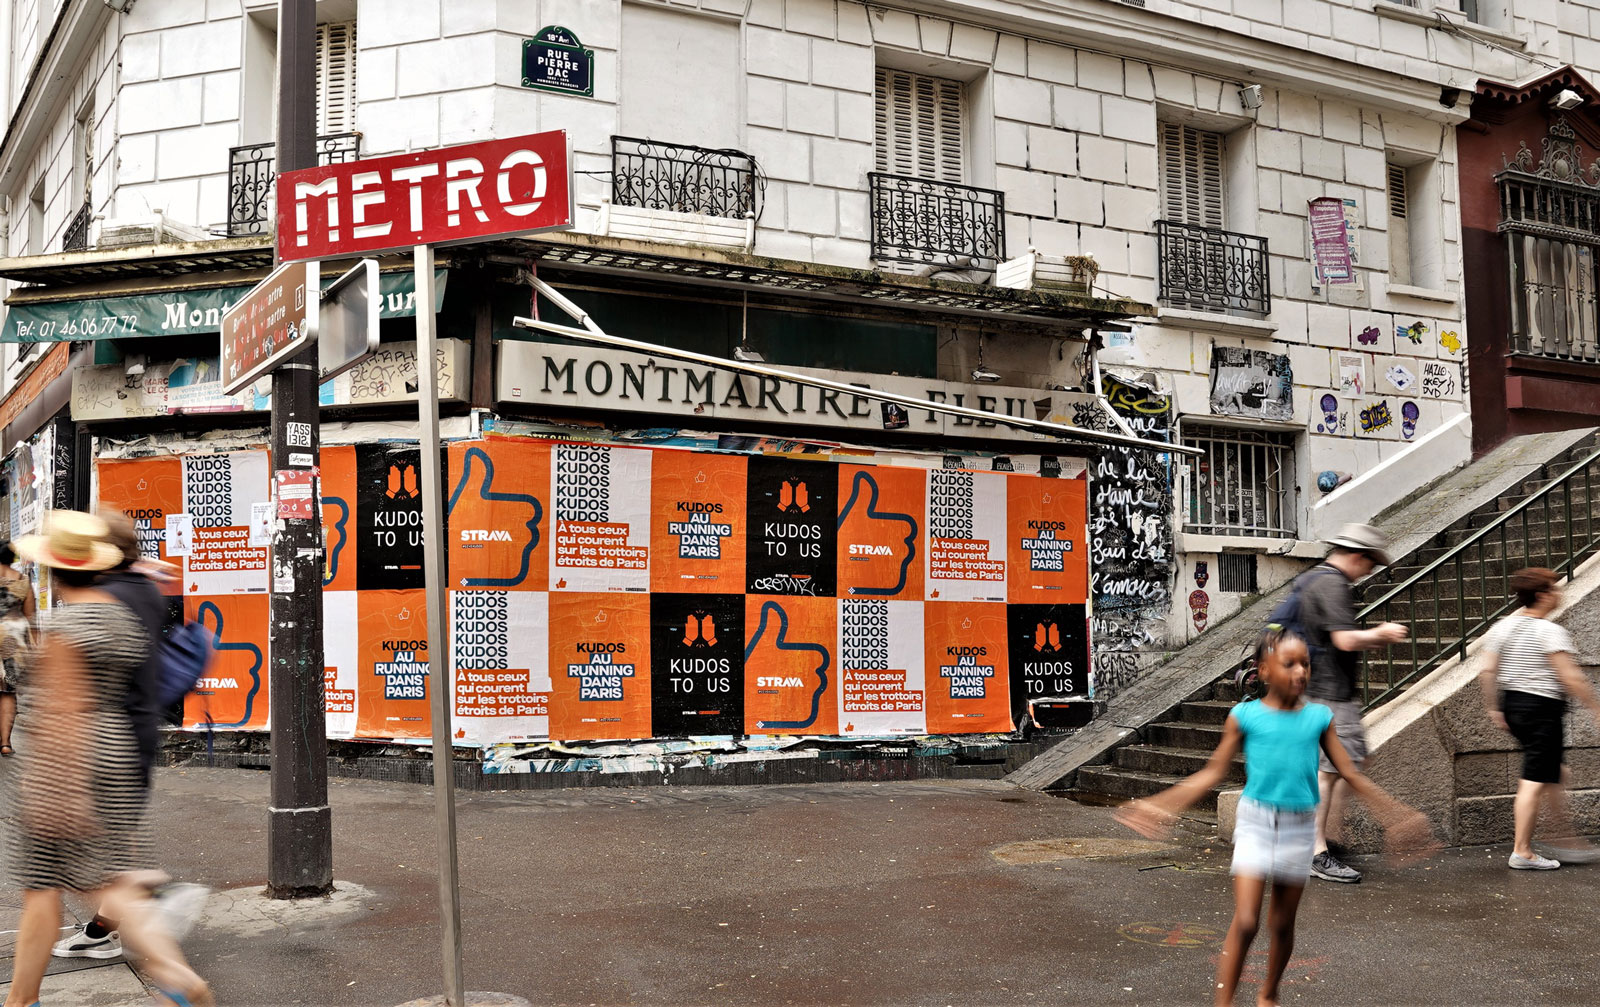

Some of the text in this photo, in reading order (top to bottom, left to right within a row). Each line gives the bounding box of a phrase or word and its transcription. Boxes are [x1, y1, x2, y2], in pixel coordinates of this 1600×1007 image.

[547, 49, 569, 60] RUE
[537, 56, 579, 71] PIERRE
[547, 67, 569, 78] DAC
[295, 149, 547, 247] METRO
[16, 315, 138, 337] Tel: 01 46 06 77 72
[541, 355, 871, 419] MONTMARTRE
[1423, 387, 1441, 398] DVD
[288, 424, 310, 435] YASS
[557, 450, 610, 463] KUDOS
[186, 459, 231, 471] KUDOS
[557, 462, 610, 475] KUDOS
[1098, 456, 1118, 478] de
[1125, 457, 1156, 480] la
[187, 471, 232, 483] KUDOS
[557, 474, 610, 487] KUDOS
[931, 475, 974, 486] KUDOS
[188, 482, 232, 494] KUDOS
[556, 486, 609, 499] KUDOS
[930, 486, 974, 497] KUDOS
[556, 498, 609, 511] KUDOS
[930, 496, 973, 507] KUDOS
[677, 502, 723, 513] KUDOS
[556, 510, 609, 522] KUDOS
[690, 514, 709, 524] AU
[558, 523, 627, 535] À tous ceux
[669, 523, 730, 536] RUNNING
[1028, 520, 1066, 530] KUDOS
[199, 530, 222, 539] tous
[223, 530, 248, 538] ceux
[460, 530, 512, 542] STRAVA
[765, 523, 821, 539] KUDOS
[930, 528, 973, 539] KUDOS
[1040, 531, 1054, 540] AU
[207, 540, 246, 549] courent
[374, 531, 396, 547] TO
[558, 536, 624, 546] qui courent
[681, 535, 719, 546] DANS
[764, 541, 821, 558] TO US
[849, 544, 893, 555] STRAVA
[932, 539, 987, 551] À tous ceux
[1022, 540, 1071, 551] RUNNING
[190, 549, 265, 560] sur les trottoirs
[558, 546, 647, 557] sur les trottoirs
[680, 546, 719, 557] PARIS
[932, 551, 985, 560] qui courent
[1032, 551, 1062, 560] DANS
[190, 558, 264, 570] étroits de Paris
[557, 557, 645, 568] étroits de Paris
[932, 560, 1003, 570] sur les trottoirs
[1031, 560, 1062, 569] PARIS
[931, 570, 1003, 580] étroits Paris
[455, 597, 508, 608] KUDOS
[455, 609, 508, 620] KUDOS
[843, 604, 888, 615] KUDOS
[843, 615, 888, 626] KUDOS
[455, 622, 508, 633] KUDOS
[843, 626, 888, 637] KUDOS
[455, 634, 508, 645] KUDOS
[382, 640, 427, 651] KUDOS
[577, 643, 625, 653] KUDOS
[947, 646, 987, 656] KUDOS
[455, 646, 508, 657] KUDOS
[395, 652, 414, 663] AU
[591, 654, 611, 664] AU
[959, 657, 975, 666] AU
[375, 663, 430, 675] RUNNING
[455, 658, 508, 669] KUDOS
[670, 658, 730, 673] KUDOS
[843, 659, 888, 670] KUDOS
[1024, 662, 1072, 676] KUDOS
[569, 665, 633, 676] RUNNING
[845, 670, 904, 681] À tous ceux
[941, 666, 993, 676] RUNNING
[386, 675, 423, 686] DANS
[457, 671, 527, 682] À tous ceux
[582, 677, 621, 687] DANS
[952, 677, 983, 686] DANS
[195, 678, 238, 689] STRAVA
[670, 678, 730, 692] TO US
[757, 677, 804, 688] STRAVA
[845, 682, 902, 692] qui courent
[1024, 679, 1073, 693] TO US
[386, 686, 424, 698] PARIS
[457, 684, 524, 695] qui courent
[581, 688, 622, 698] PARIS
[951, 687, 984, 697] PARIS
[457, 694, 548, 704] sur les trottoirs
[845, 692, 922, 701] sur les trottoirs
[326, 702, 352, 713] Paris
[457, 704, 548, 716] étroits Paris
[845, 701, 921, 711] étroits Paris
